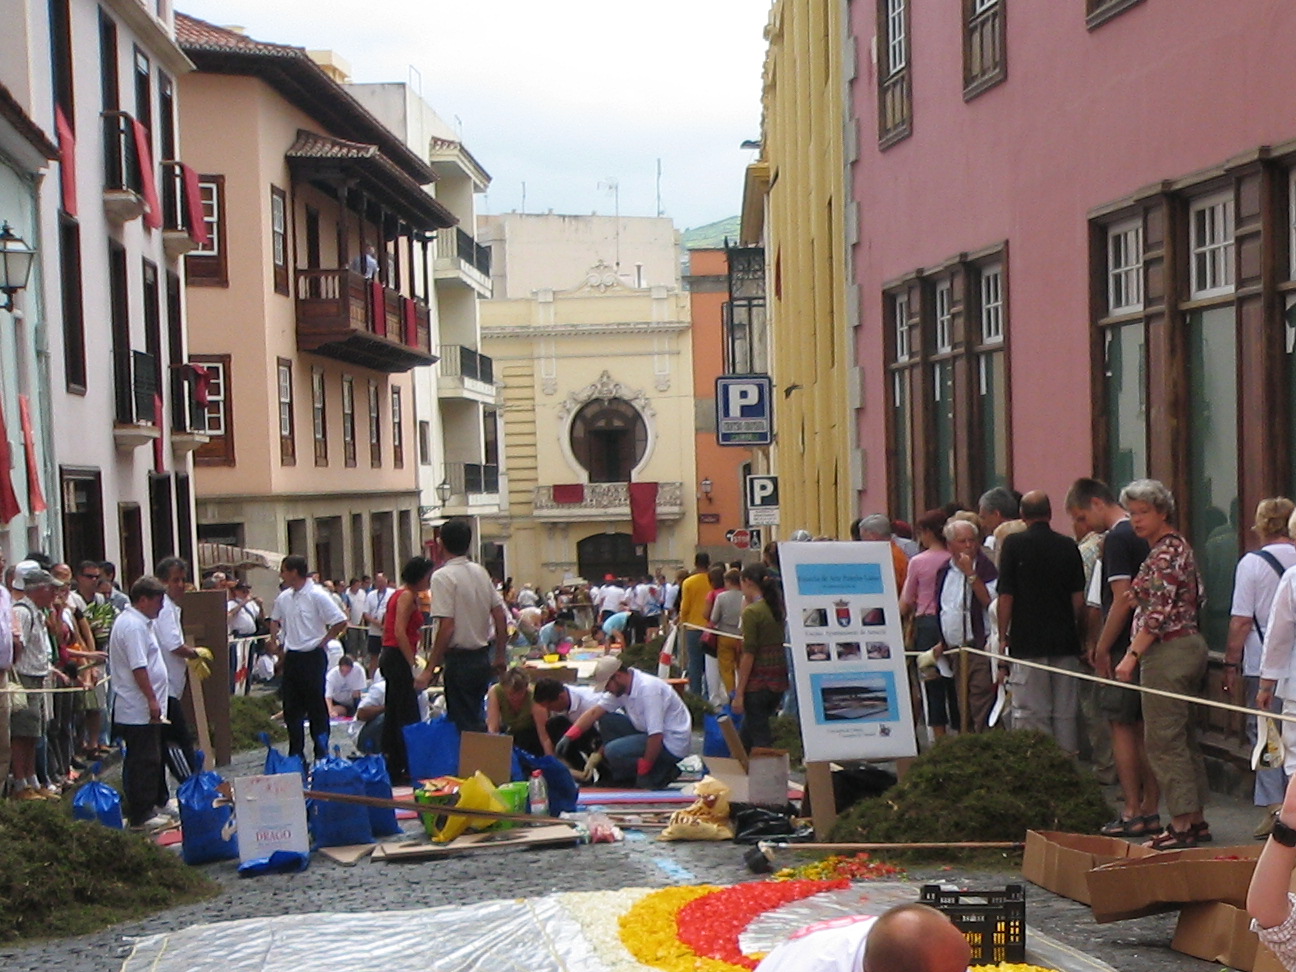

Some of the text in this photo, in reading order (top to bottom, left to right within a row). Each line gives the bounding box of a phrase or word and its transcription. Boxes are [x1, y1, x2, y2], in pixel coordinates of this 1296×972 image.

[728, 384, 759, 418] P
[753, 479, 774, 505] P
[256, 830, 292, 842] DRAGO
